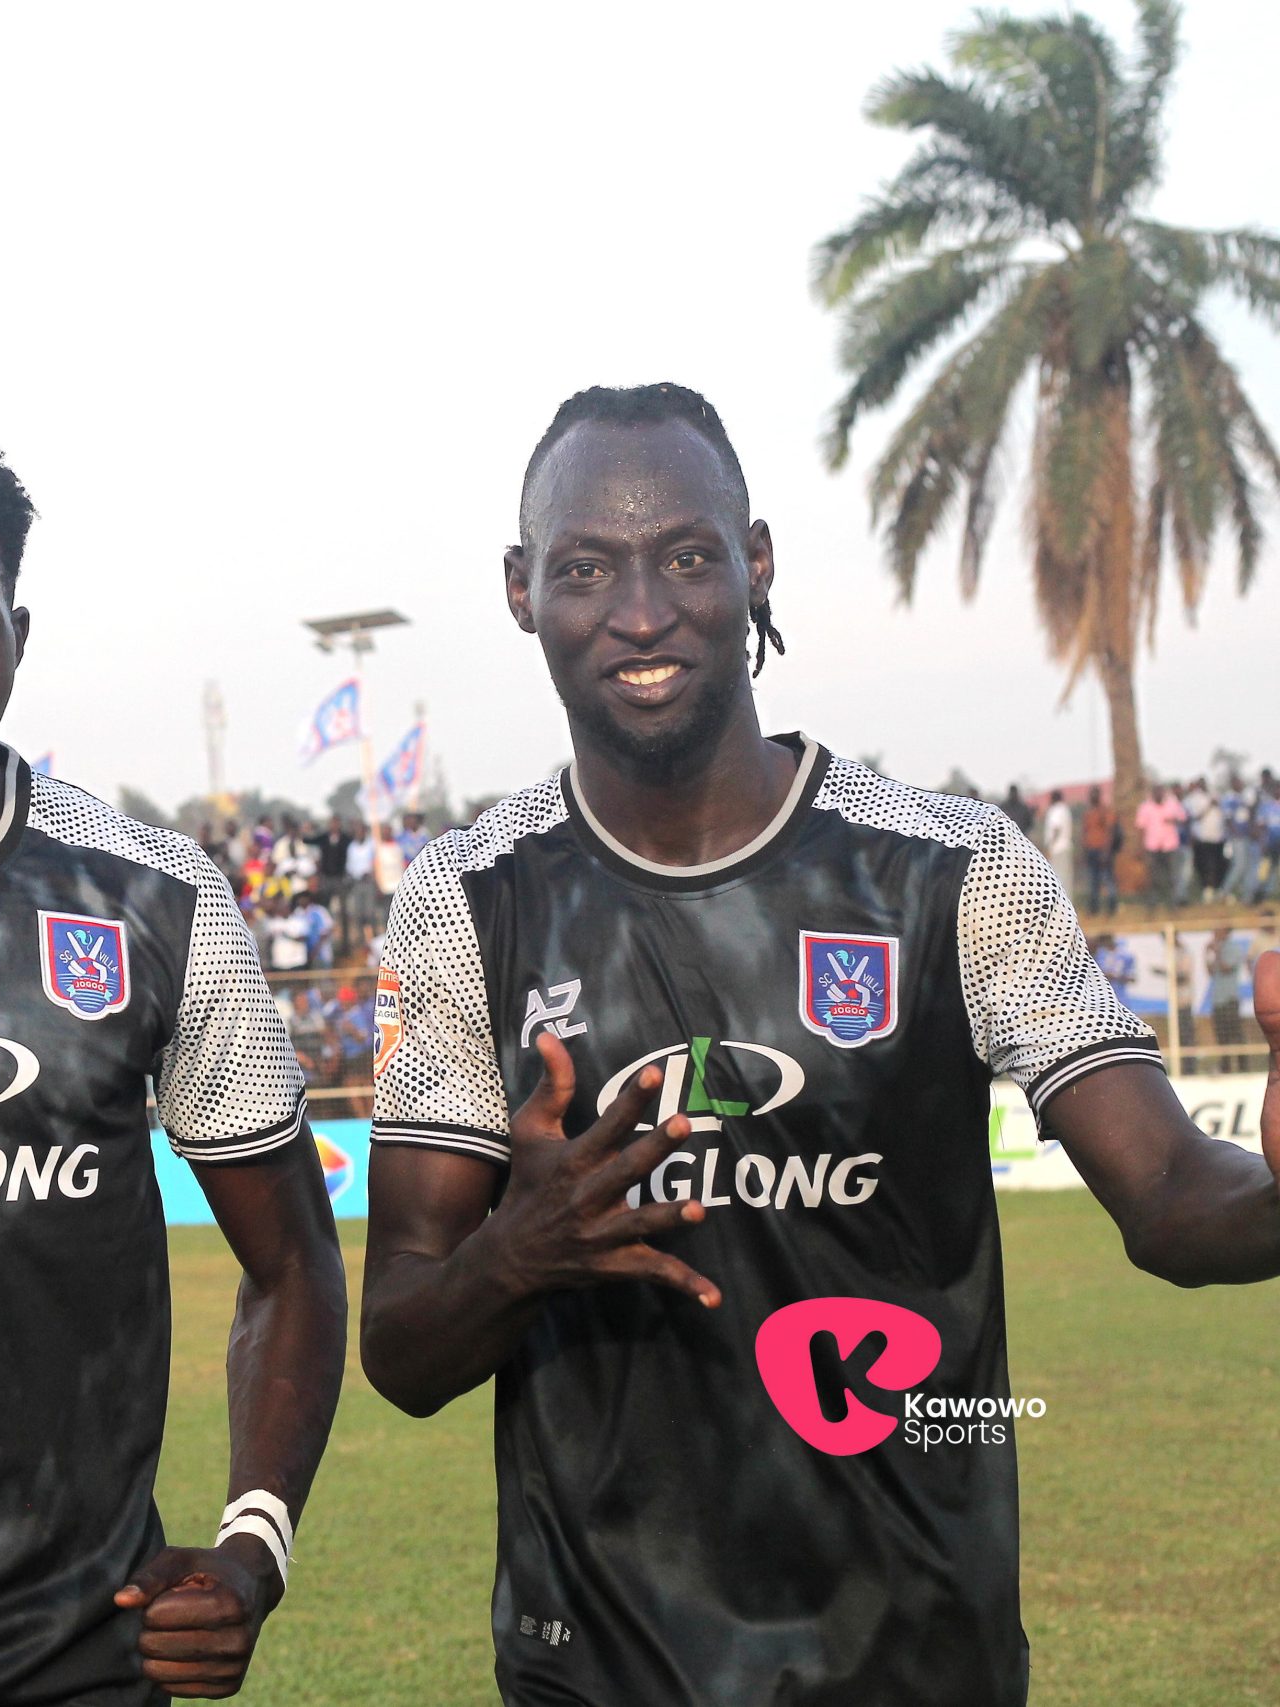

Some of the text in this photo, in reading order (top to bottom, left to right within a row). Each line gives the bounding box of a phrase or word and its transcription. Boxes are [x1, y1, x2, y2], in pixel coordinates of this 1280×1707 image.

[60, 949, 119, 974] SC VILLA
[75, 980, 104, 991] JOGOO
[819, 972, 885, 998] SC VILLA
[374, 1009, 400, 1020] EAGUE
[833, 1006, 866, 1015] JOGOO
[625, 1148, 884, 1210] GLONG
